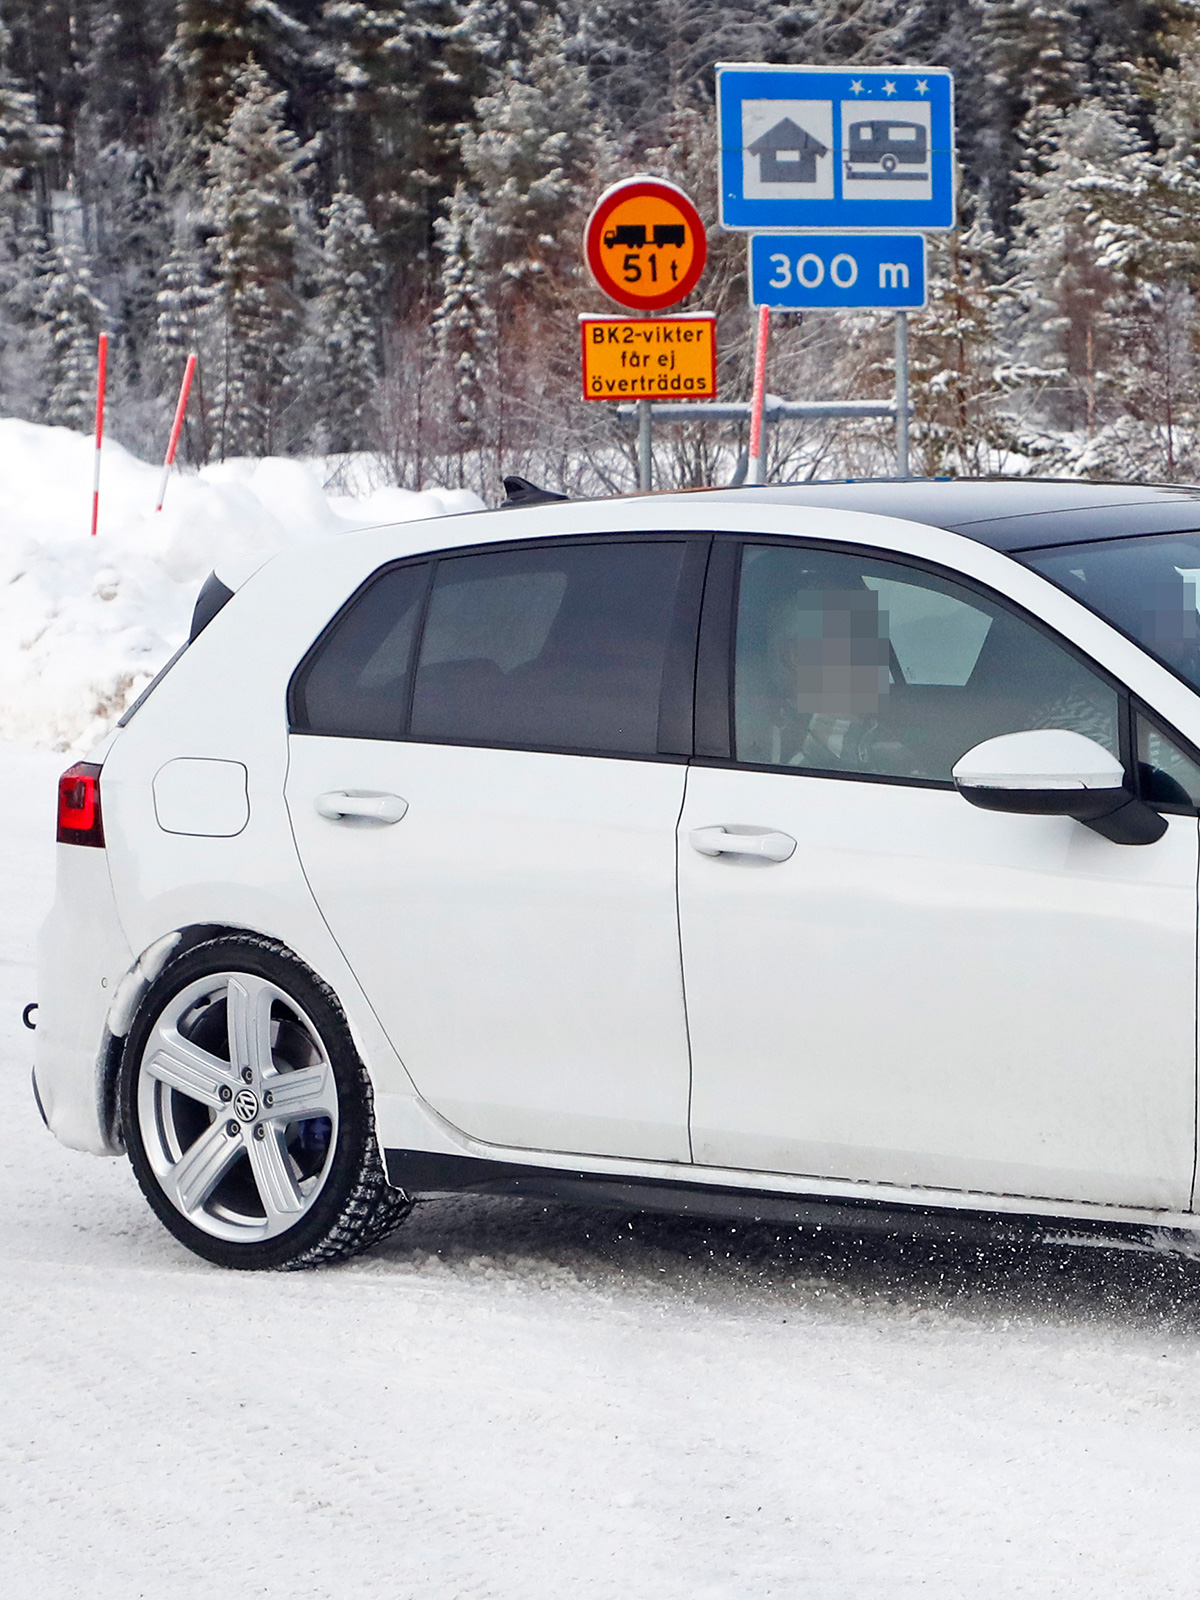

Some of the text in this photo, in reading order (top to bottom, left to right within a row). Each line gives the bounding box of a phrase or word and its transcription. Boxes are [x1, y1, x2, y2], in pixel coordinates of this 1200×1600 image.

[623, 254, 679, 282] 51 t
[769, 253, 910, 289] 300 m
[592, 326, 704, 344] BK2-vikter
[621, 350, 676, 370] får ej
[591, 374, 707, 393] överträdas
